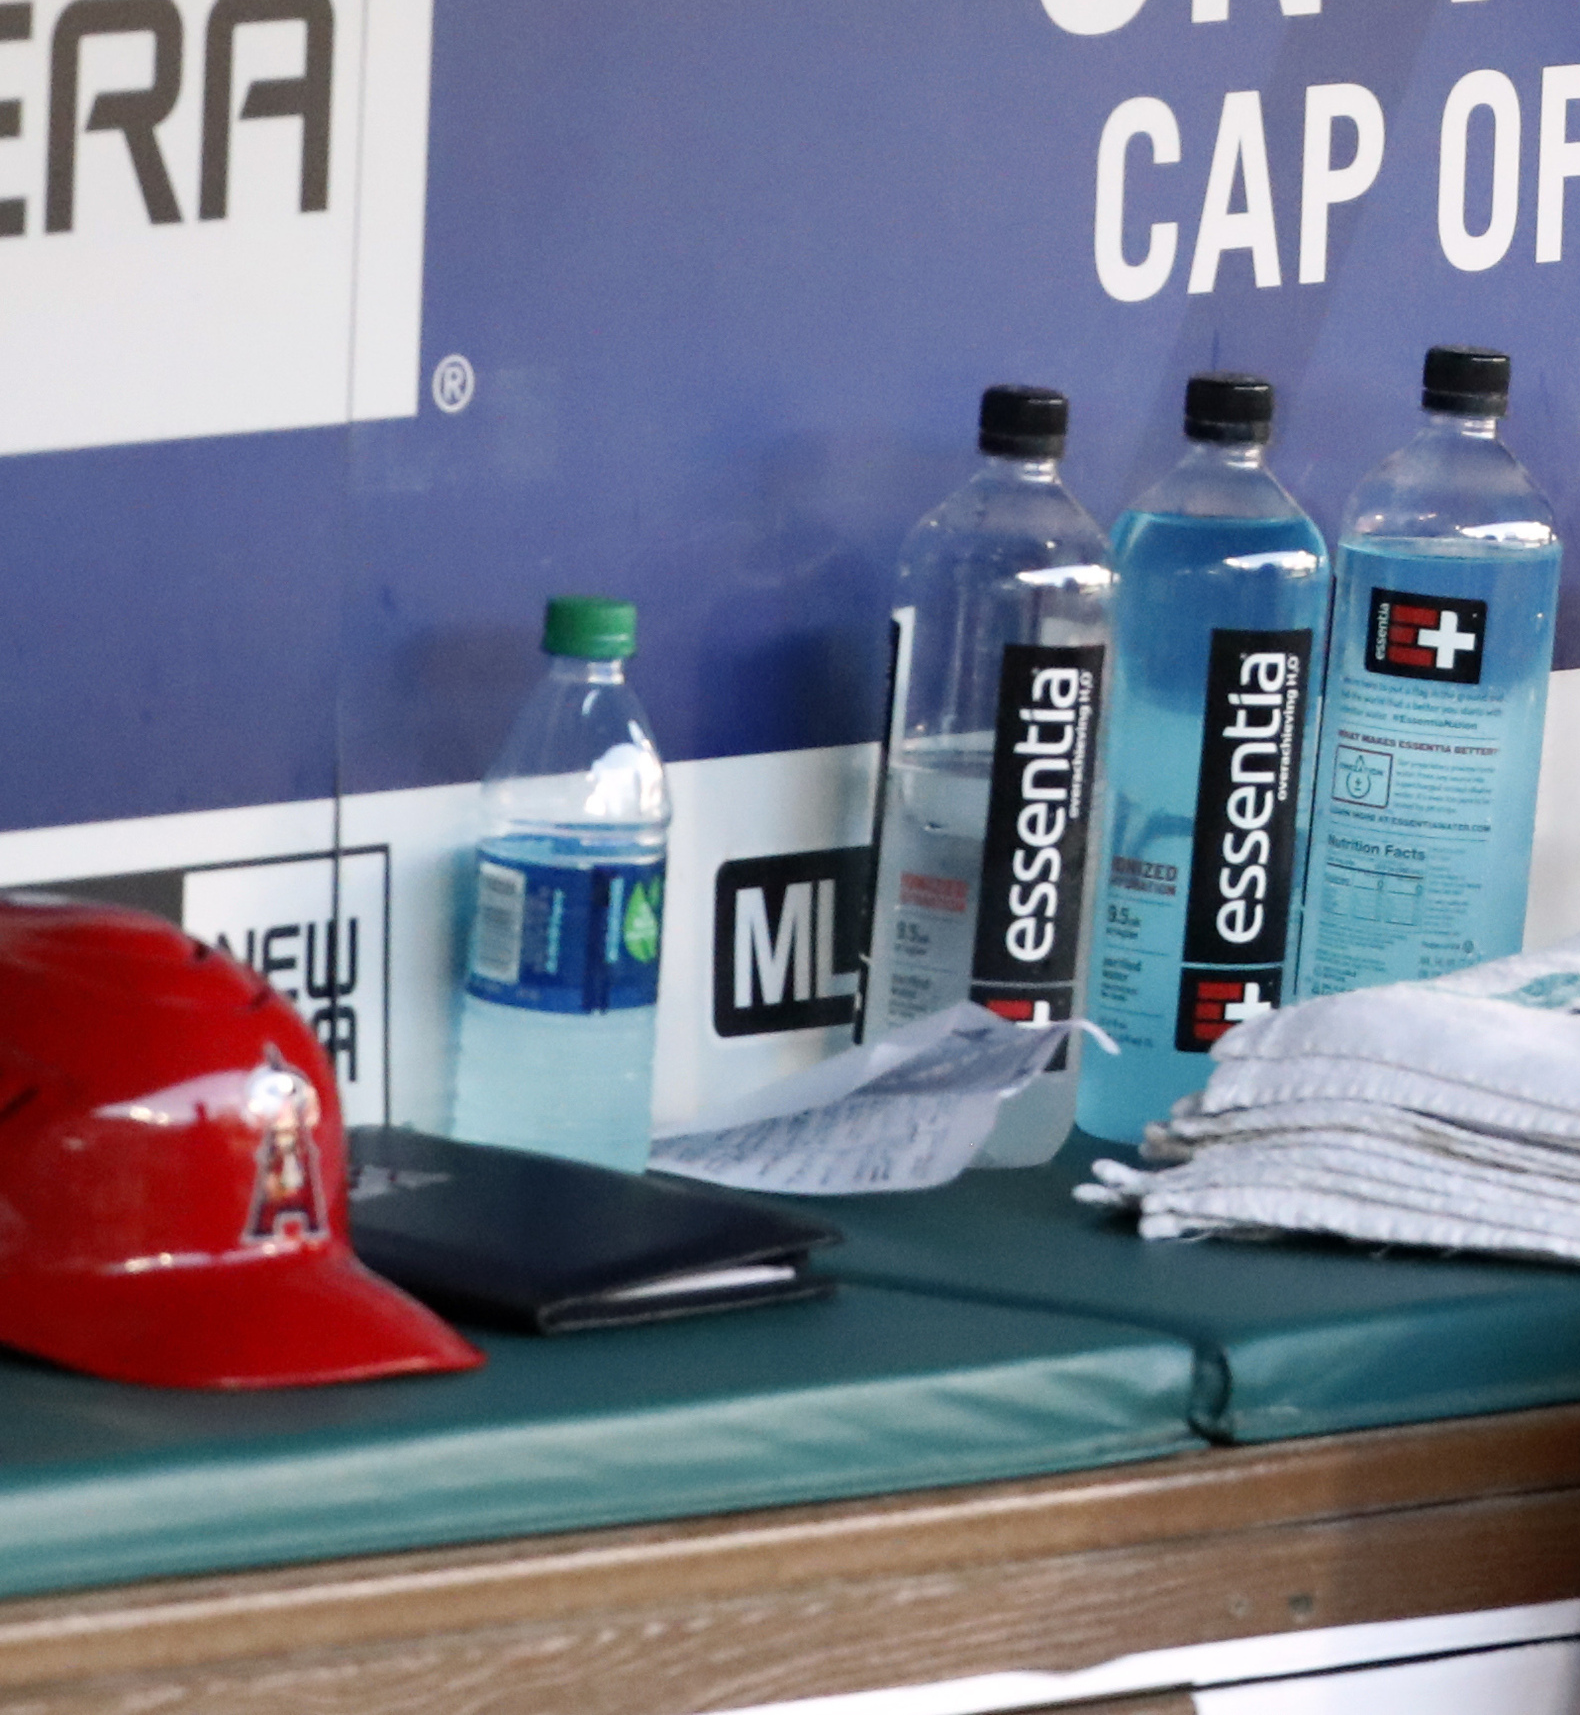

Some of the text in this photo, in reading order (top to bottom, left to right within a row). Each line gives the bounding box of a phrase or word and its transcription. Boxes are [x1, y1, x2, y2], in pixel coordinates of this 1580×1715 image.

[1094, 82, 1387, 304] CAP
[1006, 667, 1080, 963] essentia
[1215, 651, 1287, 945] essentia
[1327, 833, 1426, 861] Nutrition Facts
